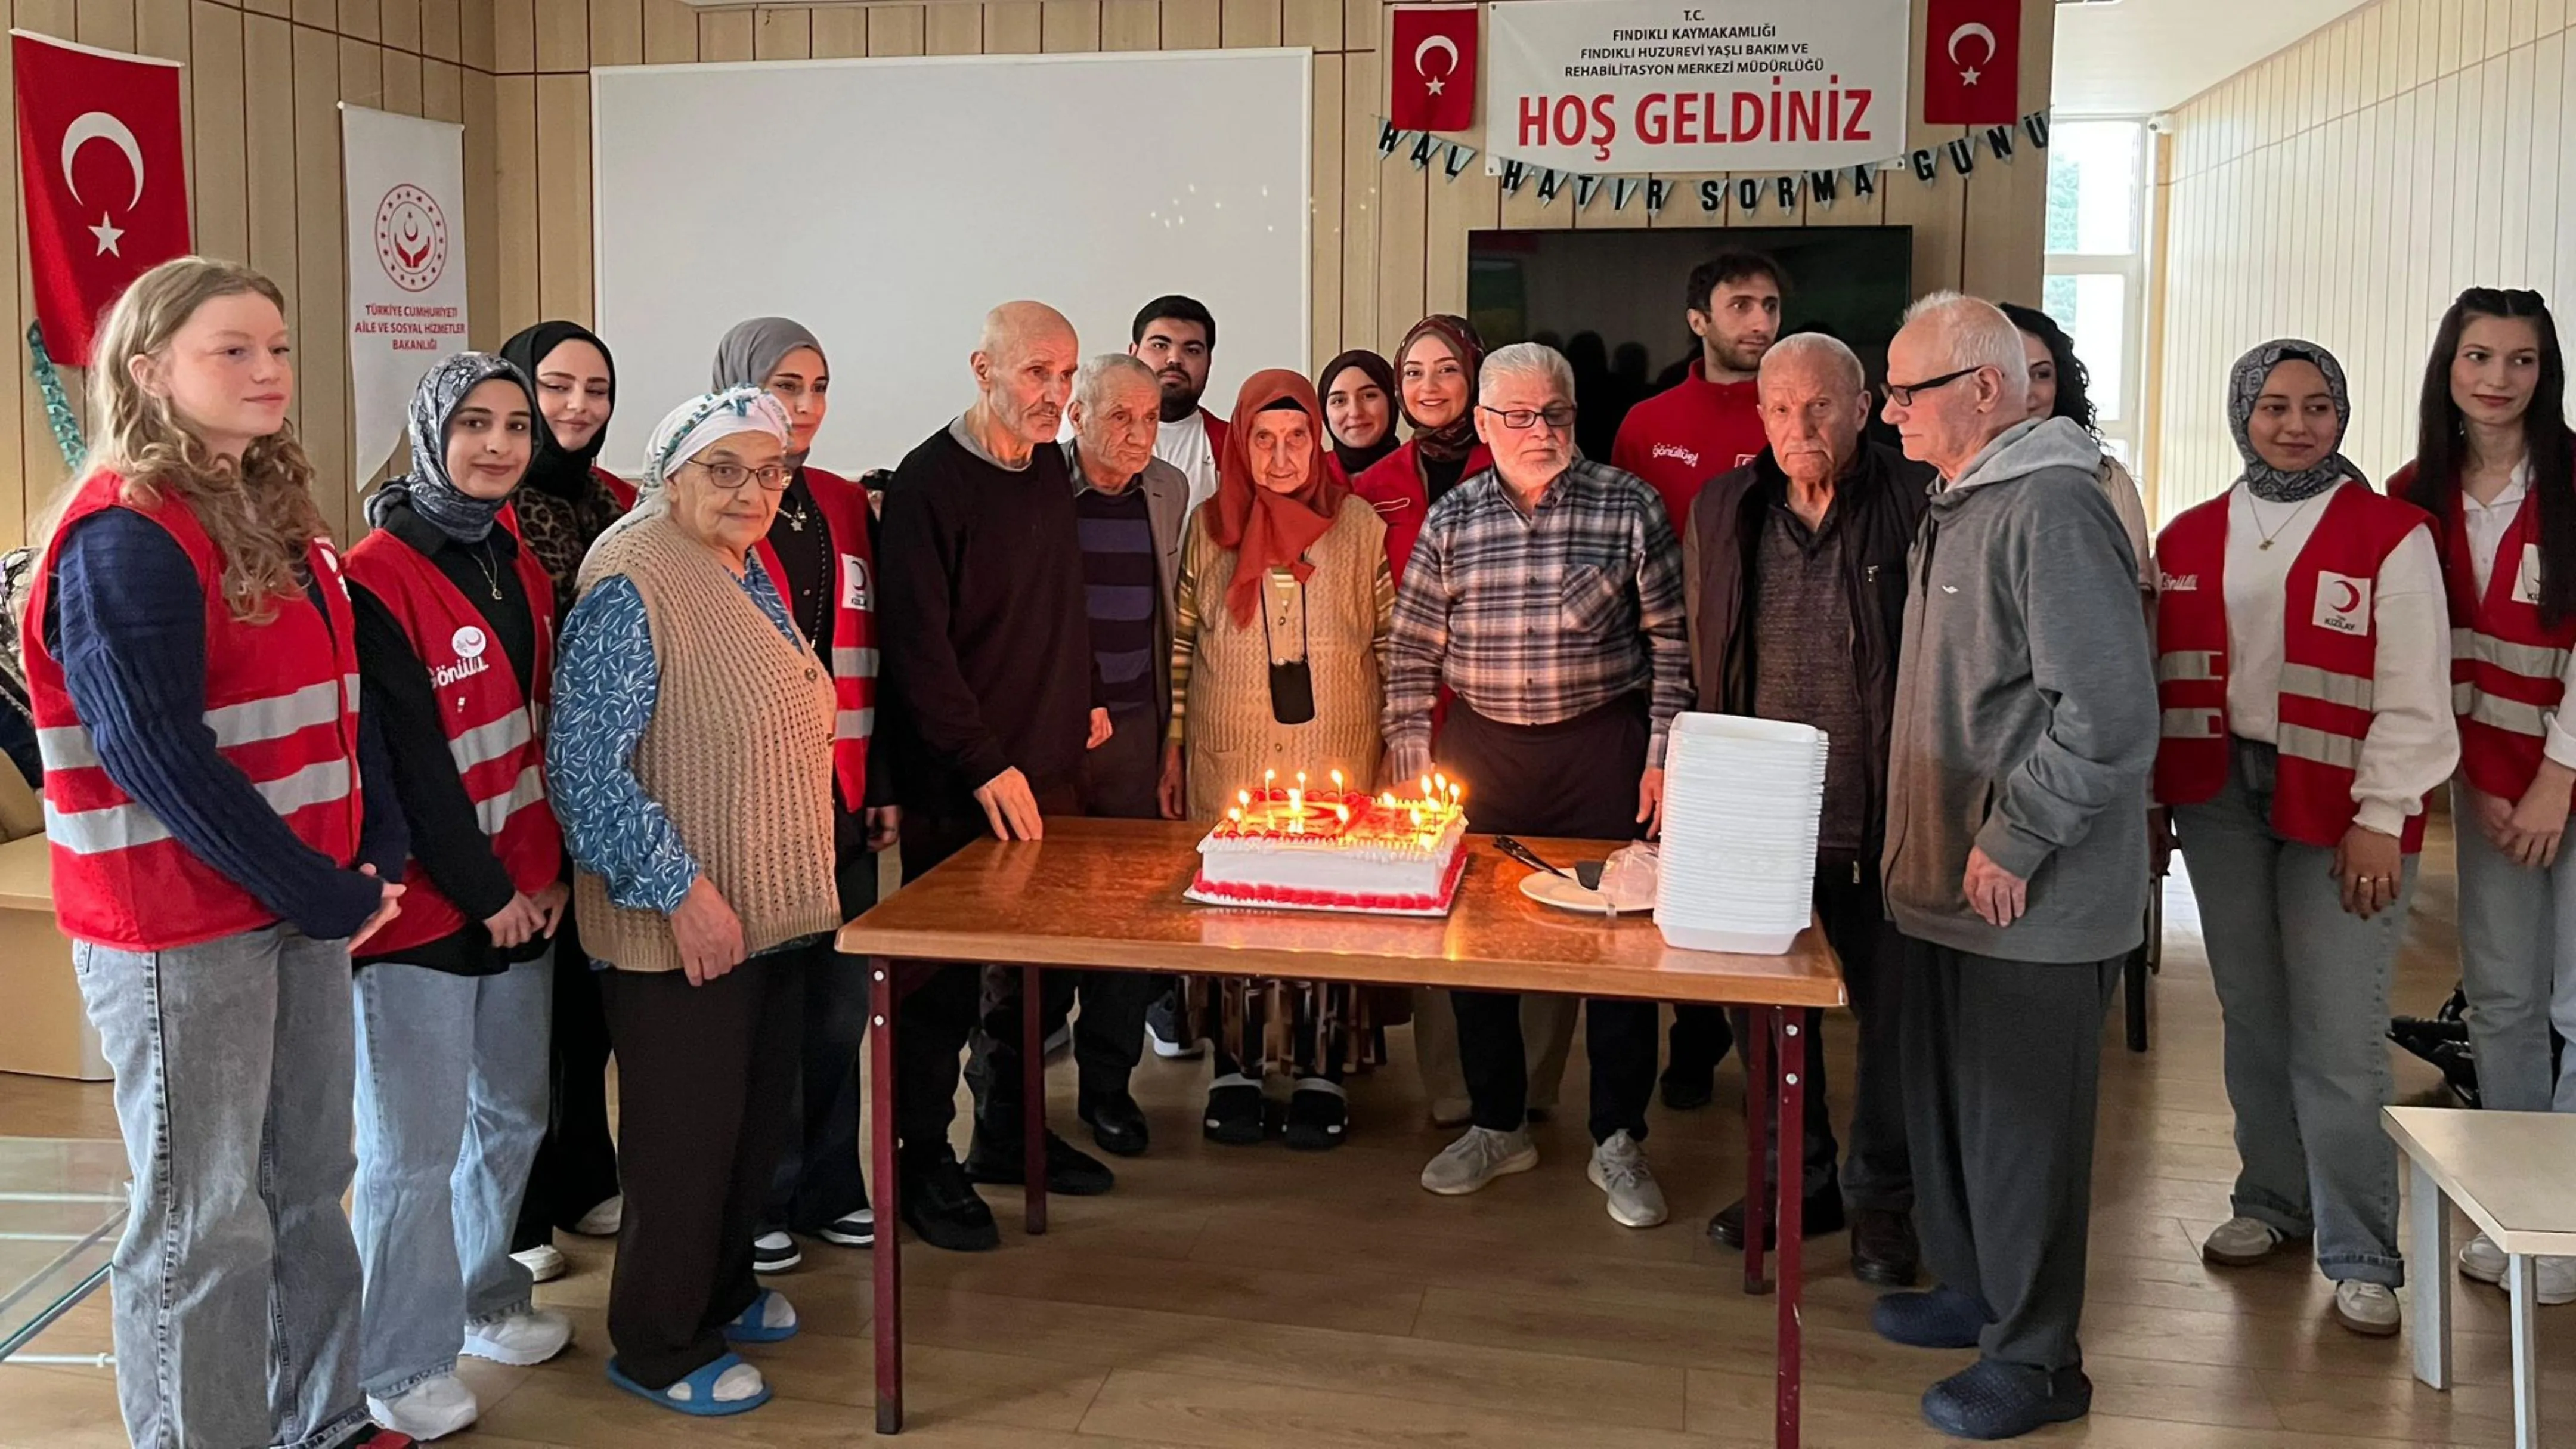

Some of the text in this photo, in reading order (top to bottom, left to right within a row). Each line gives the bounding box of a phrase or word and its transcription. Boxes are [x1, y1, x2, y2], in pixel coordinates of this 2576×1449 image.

[1683, 10, 1705, 21] T.C.
[1613, 23, 1776, 41] FINDIKLI KAYMAKAMLIĞI
[1581, 43, 1809, 59] FINDIKLI HUZUREVİ YAŞLI BAKIM VE
[1565, 58, 1824, 77] REHABİLİTASYON MERKEZİ MÜDÜRLÜĞÜ
[1518, 73, 1872, 162] HOŞ GELDİNİZ
[1379, 112, 2049, 212] HAL HATIR SORMA GÜNÜ
[366, 303, 457, 317] TÜRKİYE CUMHURİYETİ
[355, 321, 376, 333] AİLE
[378, 323, 389, 333] VE
[391, 323, 422, 333] SOSYAL
[392, 338, 437, 350] BAKANLIĞI
